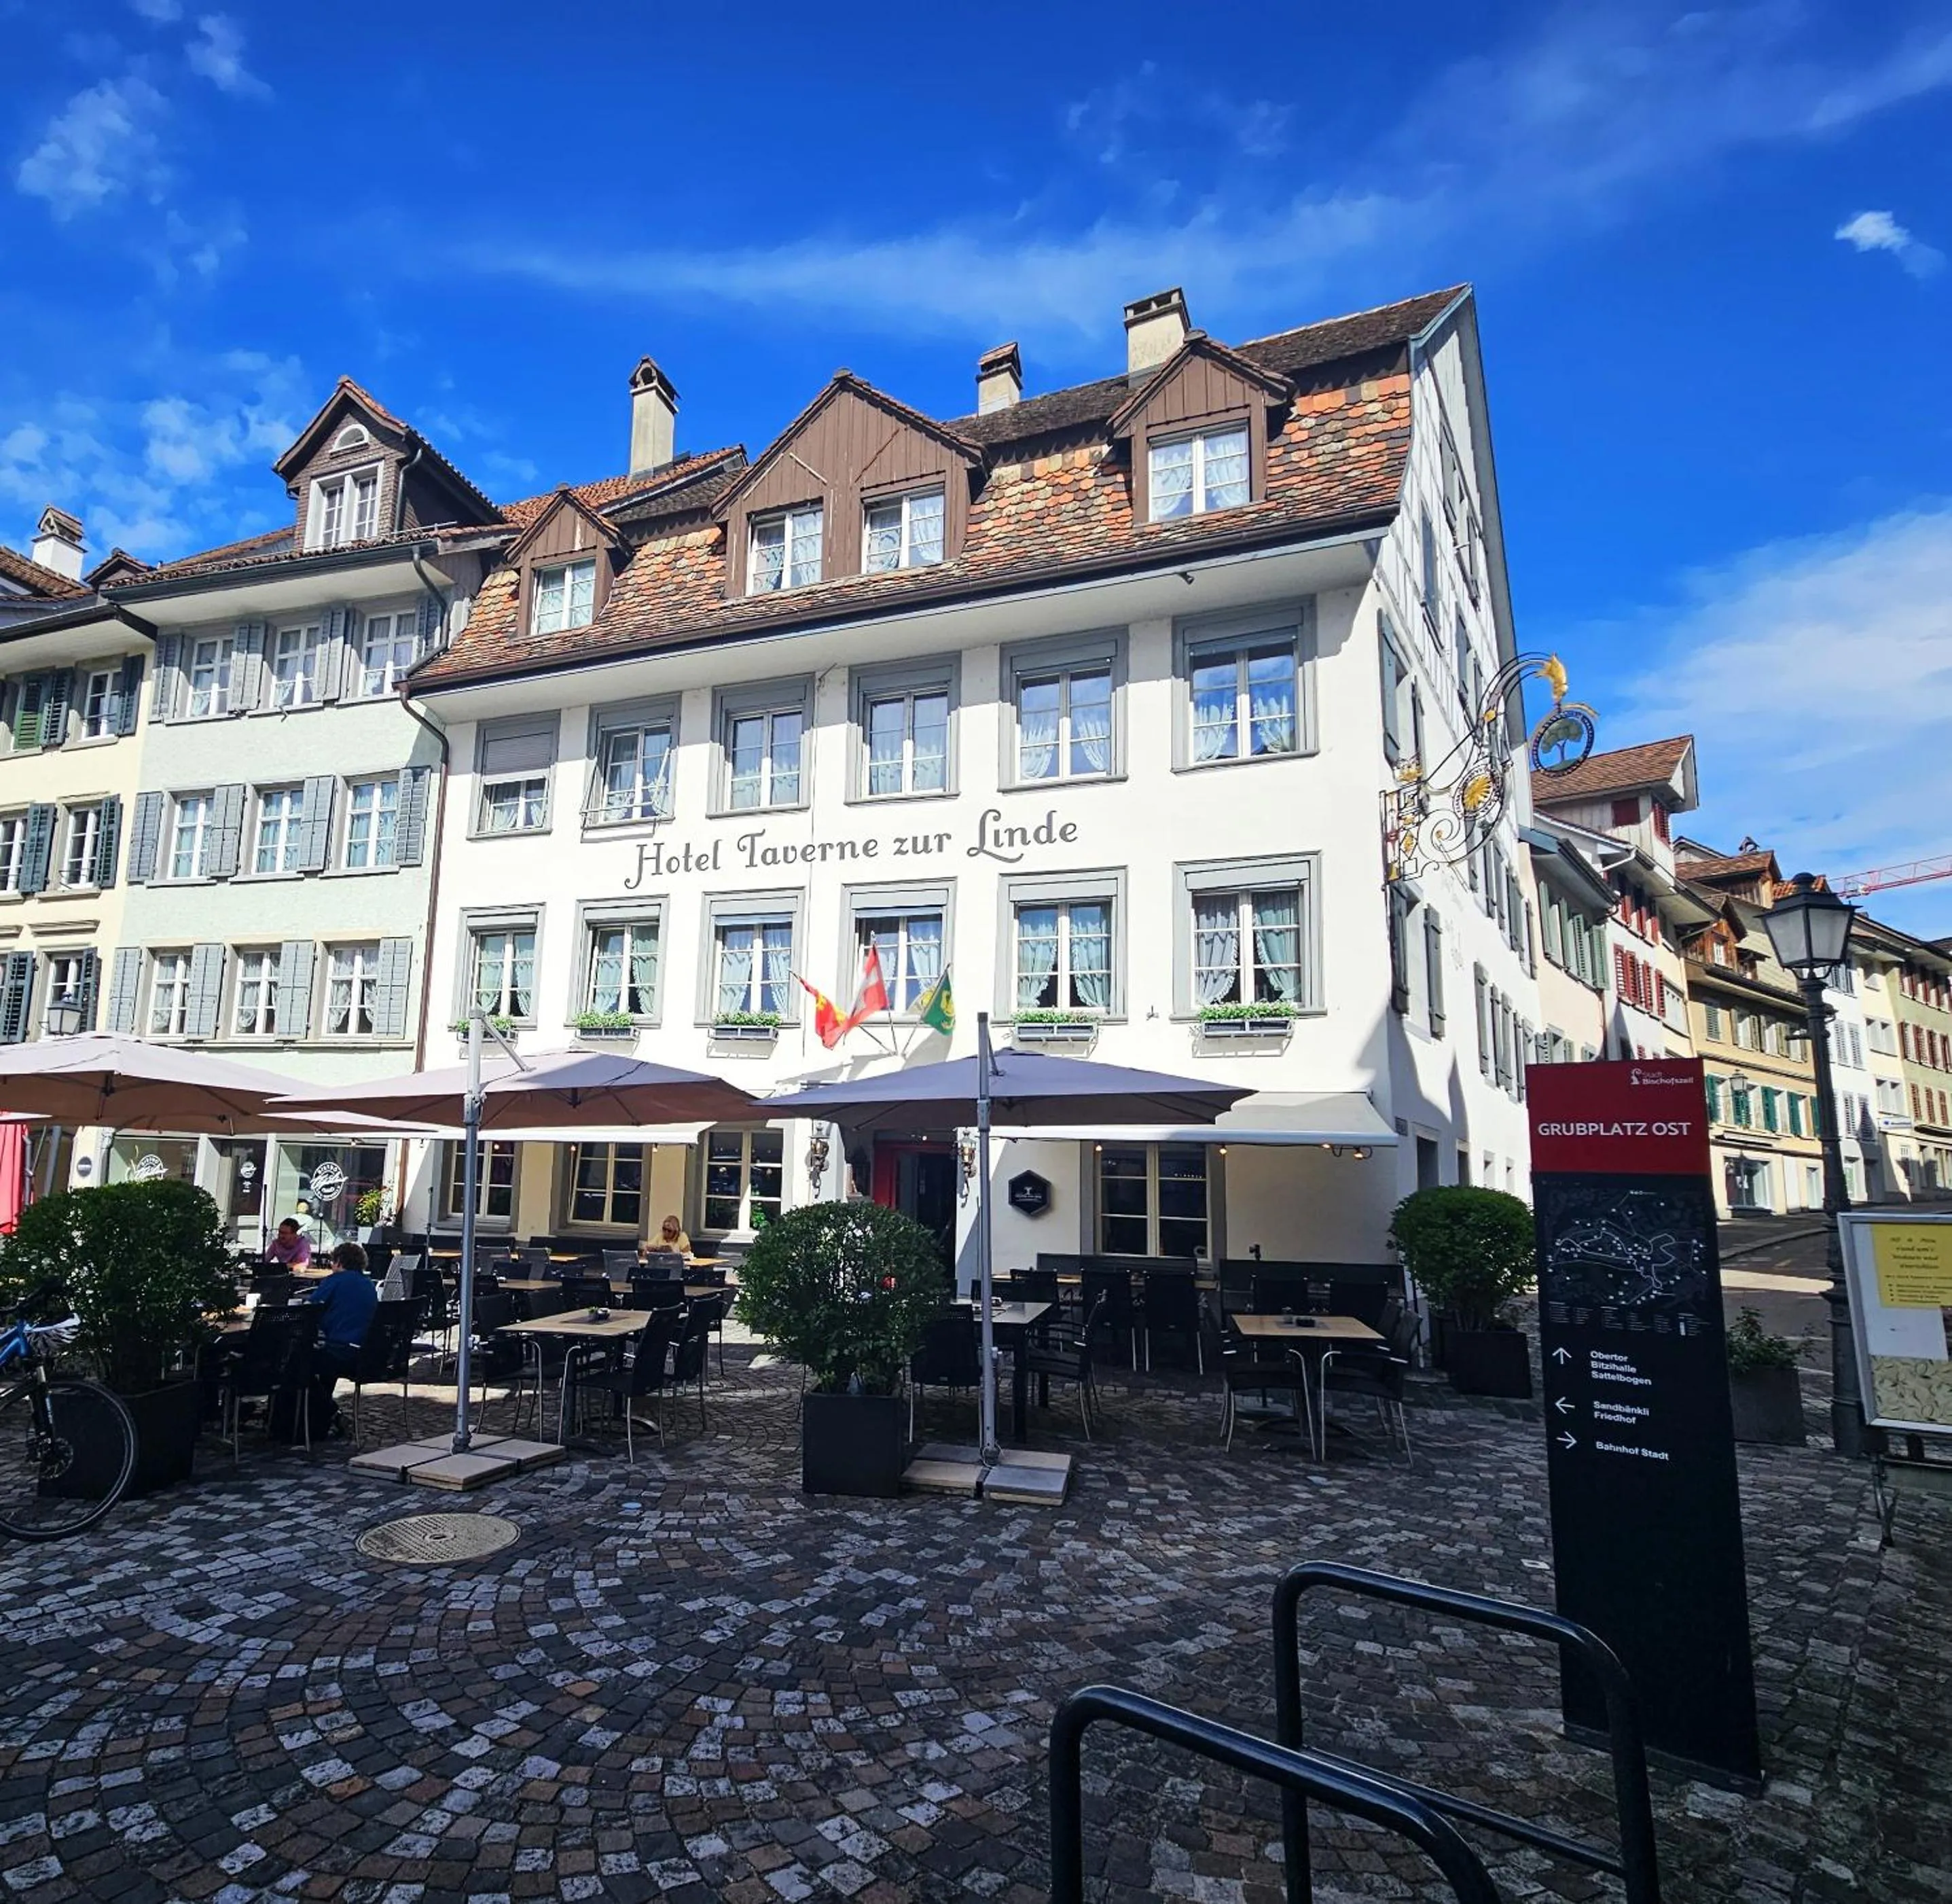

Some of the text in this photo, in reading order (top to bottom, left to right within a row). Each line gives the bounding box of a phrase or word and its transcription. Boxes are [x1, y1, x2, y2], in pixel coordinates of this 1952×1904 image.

[624, 808, 1078, 889] Hotel Taverne zur Linde
[1538, 1121, 1692, 1136] GRUBPLATZ OST
[1590, 1350, 1629, 1362] Obertor
[1591, 1360, 1638, 1373] Bitzihalle
[1591, 1370, 1652, 1385] Sattelbogen
[1593, 1401, 1650, 1416] Sandbänkli
[1594, 1411, 1637, 1424] Friedhof
[1596, 1441, 1669, 1460] Bahnhof Stadt
